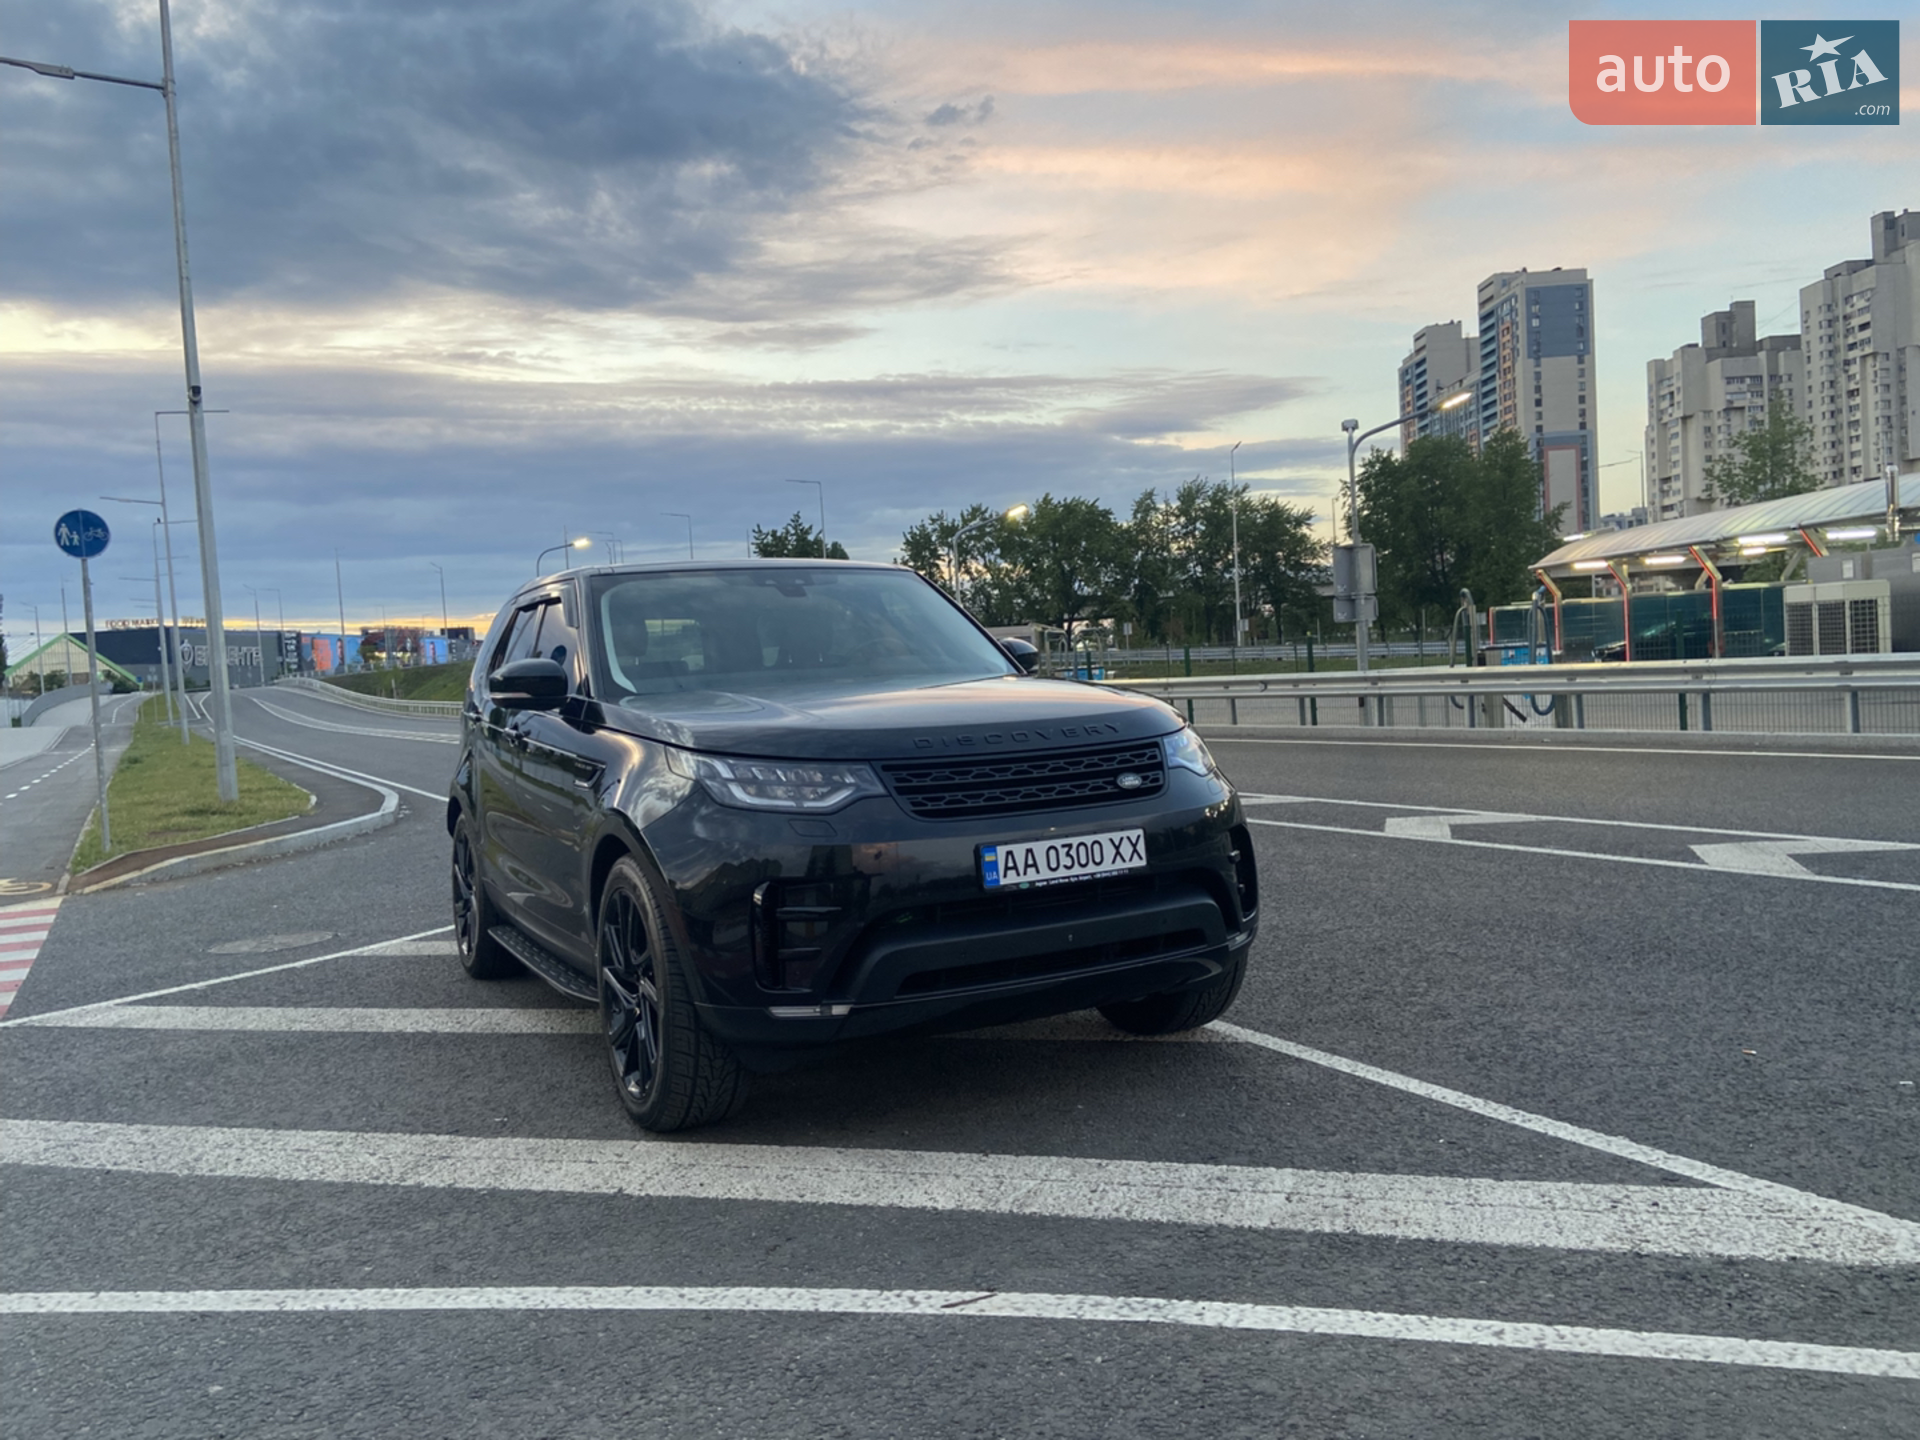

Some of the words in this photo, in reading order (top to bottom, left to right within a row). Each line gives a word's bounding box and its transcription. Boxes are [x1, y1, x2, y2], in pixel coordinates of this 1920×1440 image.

[912, 722, 1121, 749] DISCOVERY
[1002, 847, 1041, 879] AA
[1045, 839, 1105, 873] 0300
[1108, 834, 1144, 865] XX
[985, 870, 999, 881] UA
